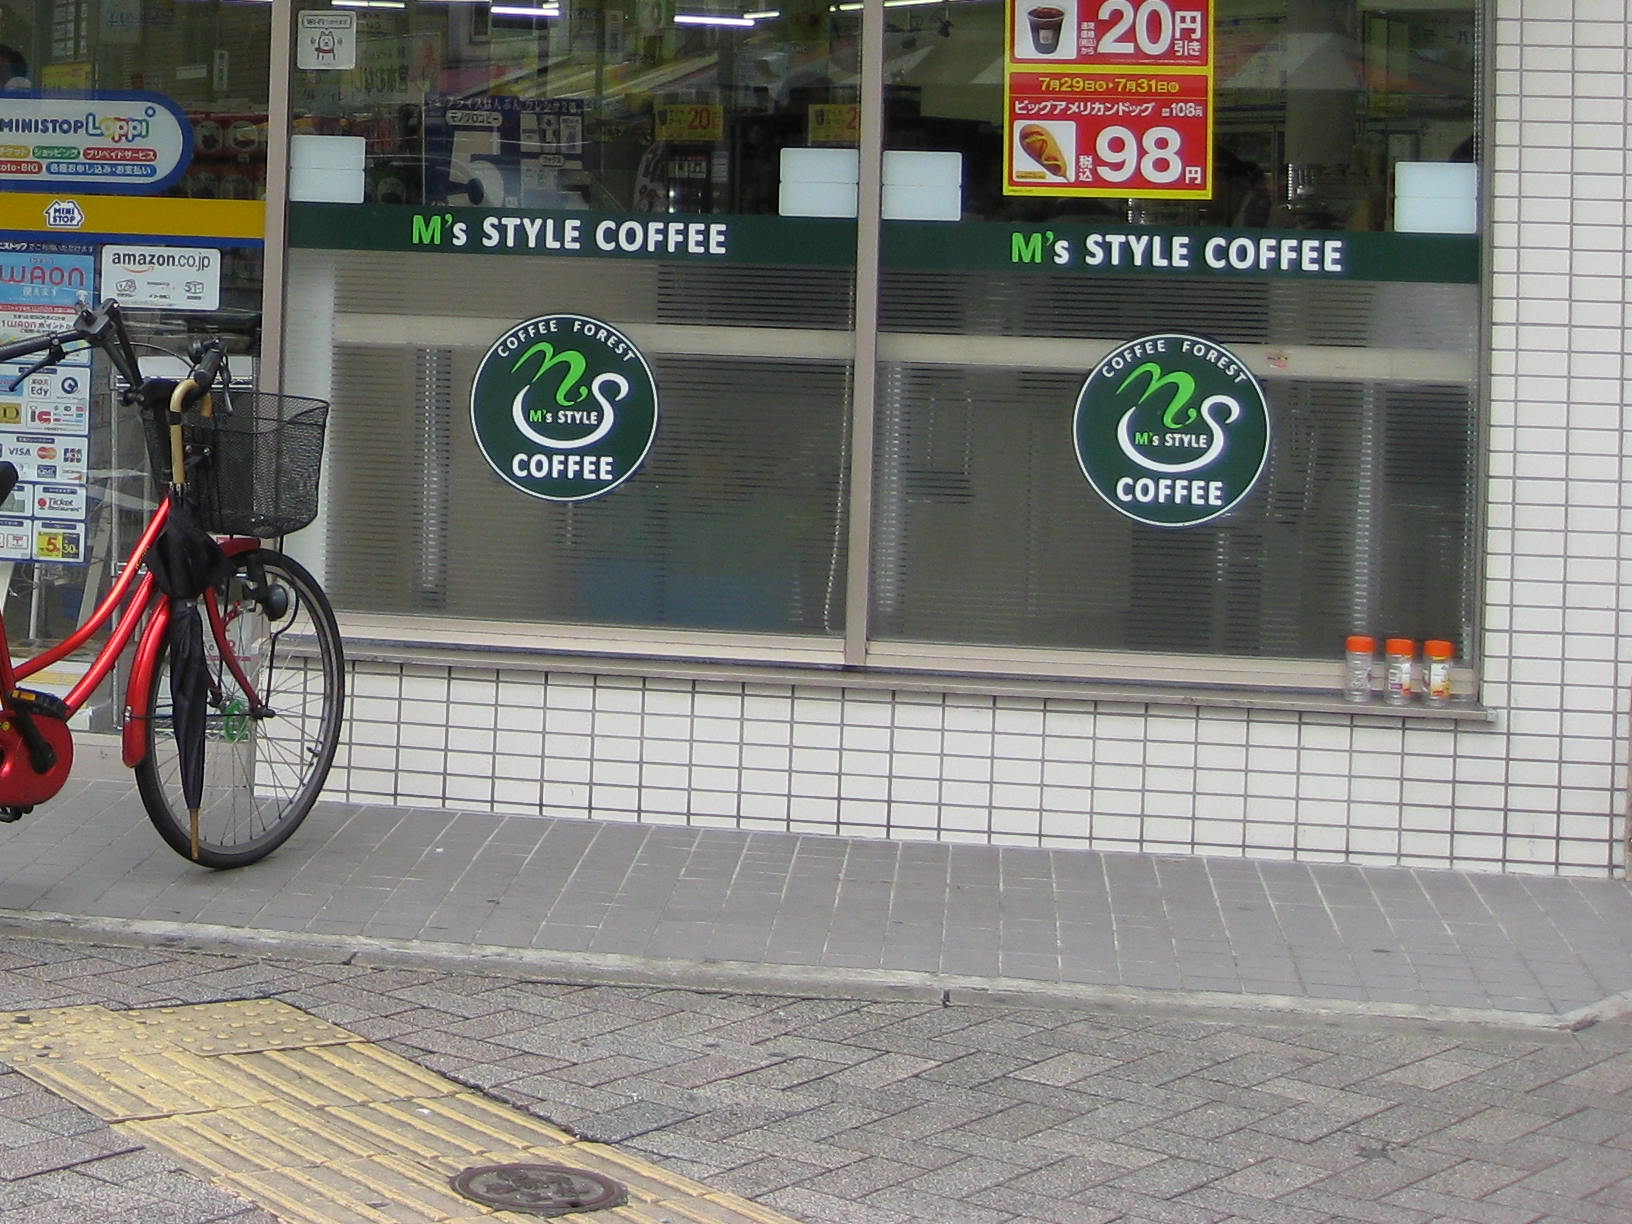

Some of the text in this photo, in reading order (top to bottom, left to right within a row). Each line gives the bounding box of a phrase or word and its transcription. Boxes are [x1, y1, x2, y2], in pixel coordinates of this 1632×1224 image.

[1174, 40, 1201, 56] 引き
[1014, 101, 1155, 117] ビッグアメリカンドッグ
[0, 113, 150, 143] MINISTOP Loppi
[1079, 155, 1093, 182] 税込
[51, 215, 76, 224] STOP
[53, 206, 75, 216] MINI
[481, 217, 581, 250] STYLE
[595, 220, 727, 255] COFFEE
[111, 251, 211, 272] amazon.co.jp
[1084, 234, 1190, 268] STYLE
[1204, 237, 1343, 272] COFFEE
[497, 320, 636, 362] COFFEE FOREST
[1101, 339, 1248, 385] COFFEE FOREST
[30, 386, 50, 397] Edy
[557, 410, 598, 425] STYLE
[1164, 433, 1208, 448] STYLE
[8, 447, 31, 456] VISA
[512, 452, 614, 480] COFFEE
[1116, 476, 1223, 506] COFFEE
[48, 497, 74, 507] Ticket
